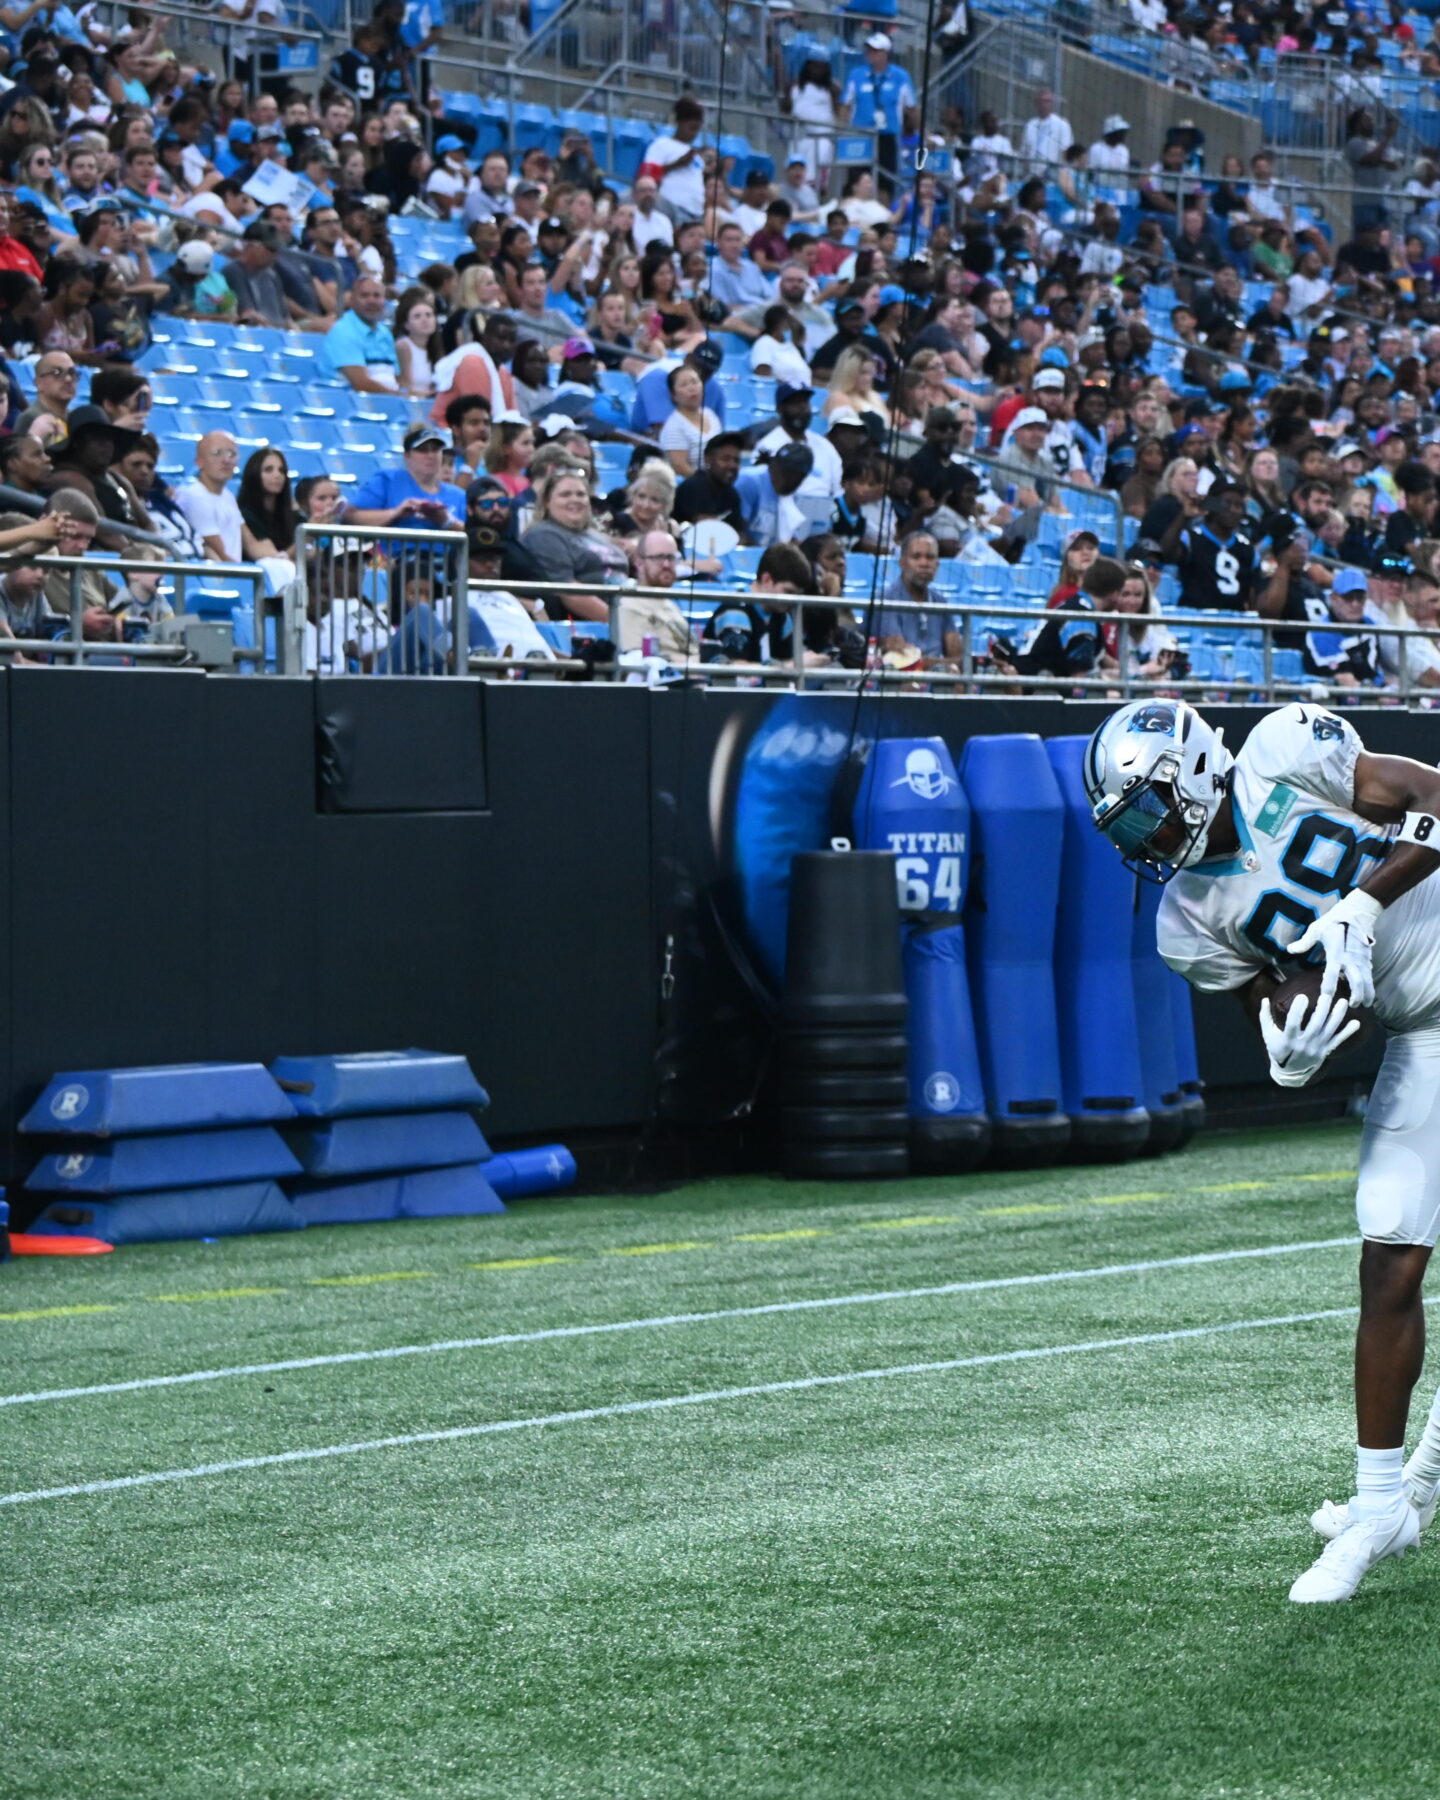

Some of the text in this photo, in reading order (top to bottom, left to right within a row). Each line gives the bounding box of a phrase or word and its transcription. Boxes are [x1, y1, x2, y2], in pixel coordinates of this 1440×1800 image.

[356, 65, 375, 100] 9
[1215, 550, 1241, 596] 9
[887, 832, 966, 854] TITAN
[1413, 815, 1435, 842] 8
[895, 856, 962, 912] 64
